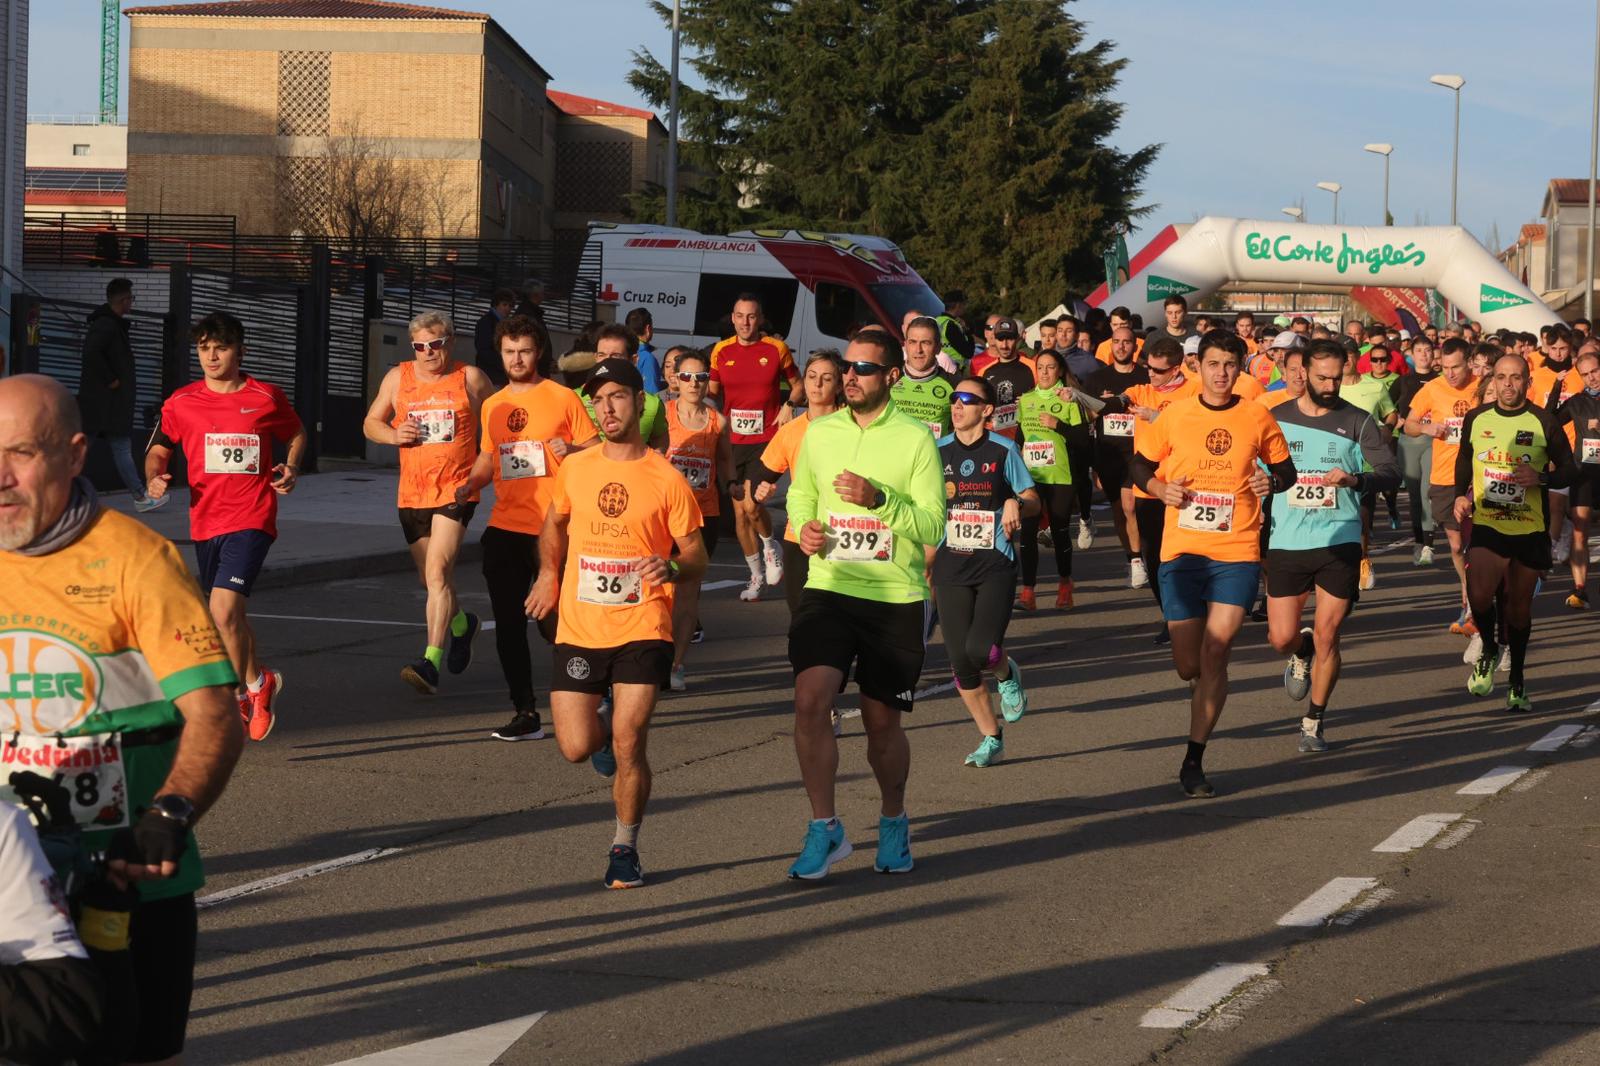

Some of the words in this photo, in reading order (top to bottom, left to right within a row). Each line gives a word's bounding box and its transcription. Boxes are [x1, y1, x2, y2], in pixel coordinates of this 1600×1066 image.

[677, 240, 757, 252] AMBULANCIA
[1245, 232, 1271, 260] El
[1273, 235, 1334, 264] Corte
[1336, 233, 1426, 274] Inglés
[623, 290, 654, 304] Cruz
[657, 291, 687, 307] Roja
[736, 419, 756, 428] 297
[1110, 421, 1127, 430] 379
[222, 448, 244, 463] 98
[511, 456, 529, 469] 35
[1030, 451, 1047, 460] 104
[1198, 459, 1233, 471] UPSA
[959, 482, 992, 490] Botanik
[1296, 486, 1325, 500] 263
[1489, 481, 1517, 496] 285
[1195, 506, 1217, 522] 25
[591, 522, 630, 538] UPSA
[955, 524, 983, 539] 182
[840, 531, 879, 550] 399
[580, 558, 636, 575] beduni
[597, 575, 622, 594] 36
[2, 740, 120, 767] bedunia
